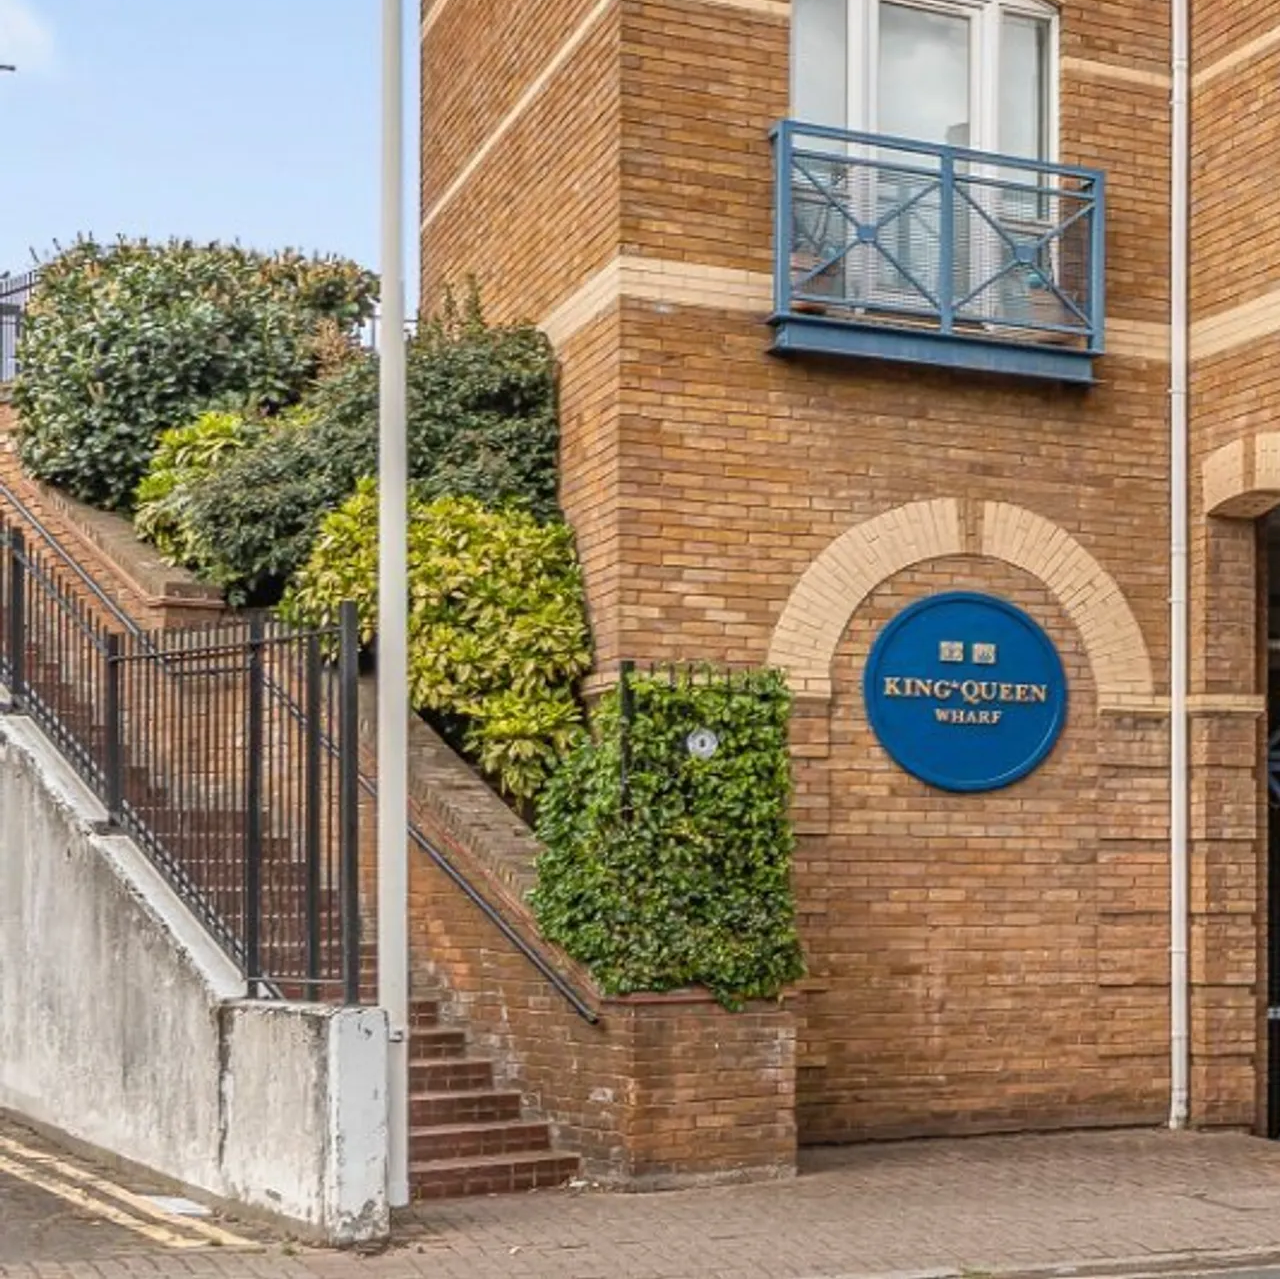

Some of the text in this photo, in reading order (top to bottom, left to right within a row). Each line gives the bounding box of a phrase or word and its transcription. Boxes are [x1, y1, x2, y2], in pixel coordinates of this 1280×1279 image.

[883, 677, 1048, 703] KING QUEEN
[934, 708, 1003, 724] WHARF
